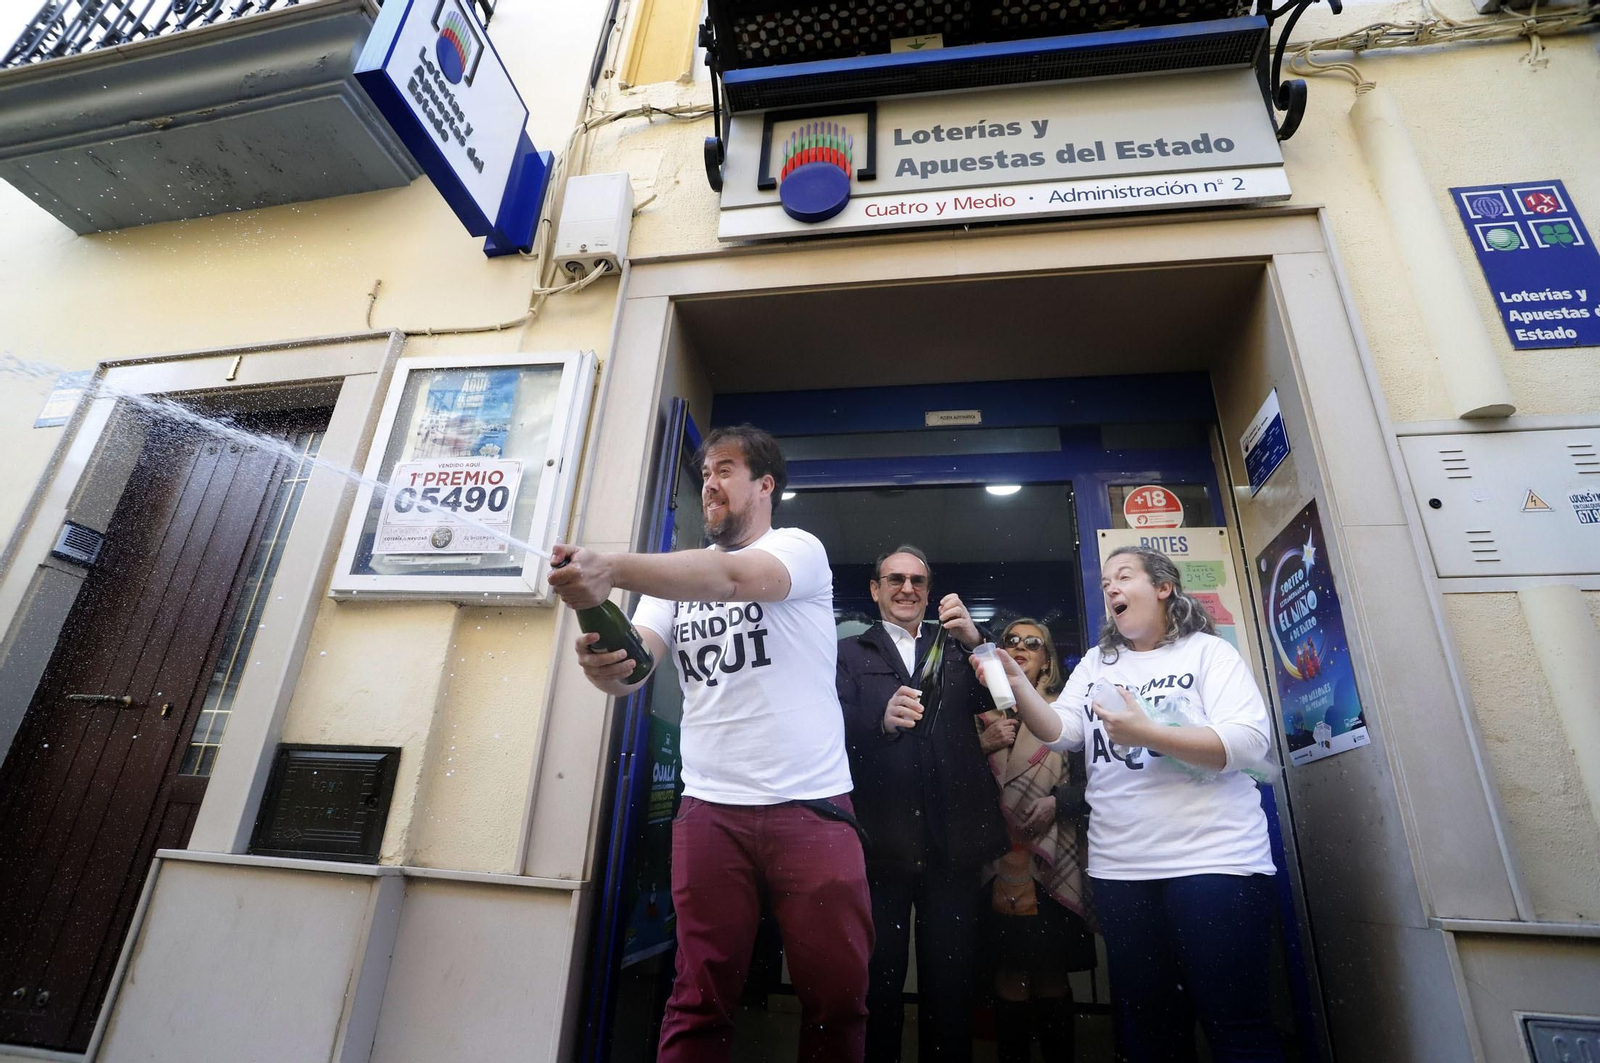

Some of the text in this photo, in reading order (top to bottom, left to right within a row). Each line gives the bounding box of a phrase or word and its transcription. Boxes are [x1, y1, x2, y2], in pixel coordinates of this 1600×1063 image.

[407, 76, 448, 141] Estado
[413, 64, 485, 175] Apuestas del
[465, 122, 474, 138] y
[893, 116, 1050, 147] Loterías y
[894, 132, 1235, 181] Apuestas del Estado
[864, 201, 929, 219] Cuatro
[935, 202, 948, 216] y
[952, 192, 1016, 212] Medio
[1049, 179, 1198, 205] Administración
[1234, 177, 1246, 191] 2
[1500, 288, 1588, 303] Loterías y
[1509, 307, 1590, 324] Apuestas
[1515, 326, 1577, 341] Estado
[464, 461, 481, 469] AQUÍ
[423, 470, 504, 487] PREMIO
[394, 484, 510, 514] 05490
[1134, 490, 1167, 508] +18
[1140, 535, 1188, 553] BOTES
[1280, 569, 1304, 596] SORTEO
[1278, 590, 1317, 632] EL NIÑO
[1293, 629, 1300, 640] DE
[1300, 616, 1317, 635] ENERO
[678, 624, 771, 687] AQUÍ
[653, 758, 676, 783] OJALÁ
